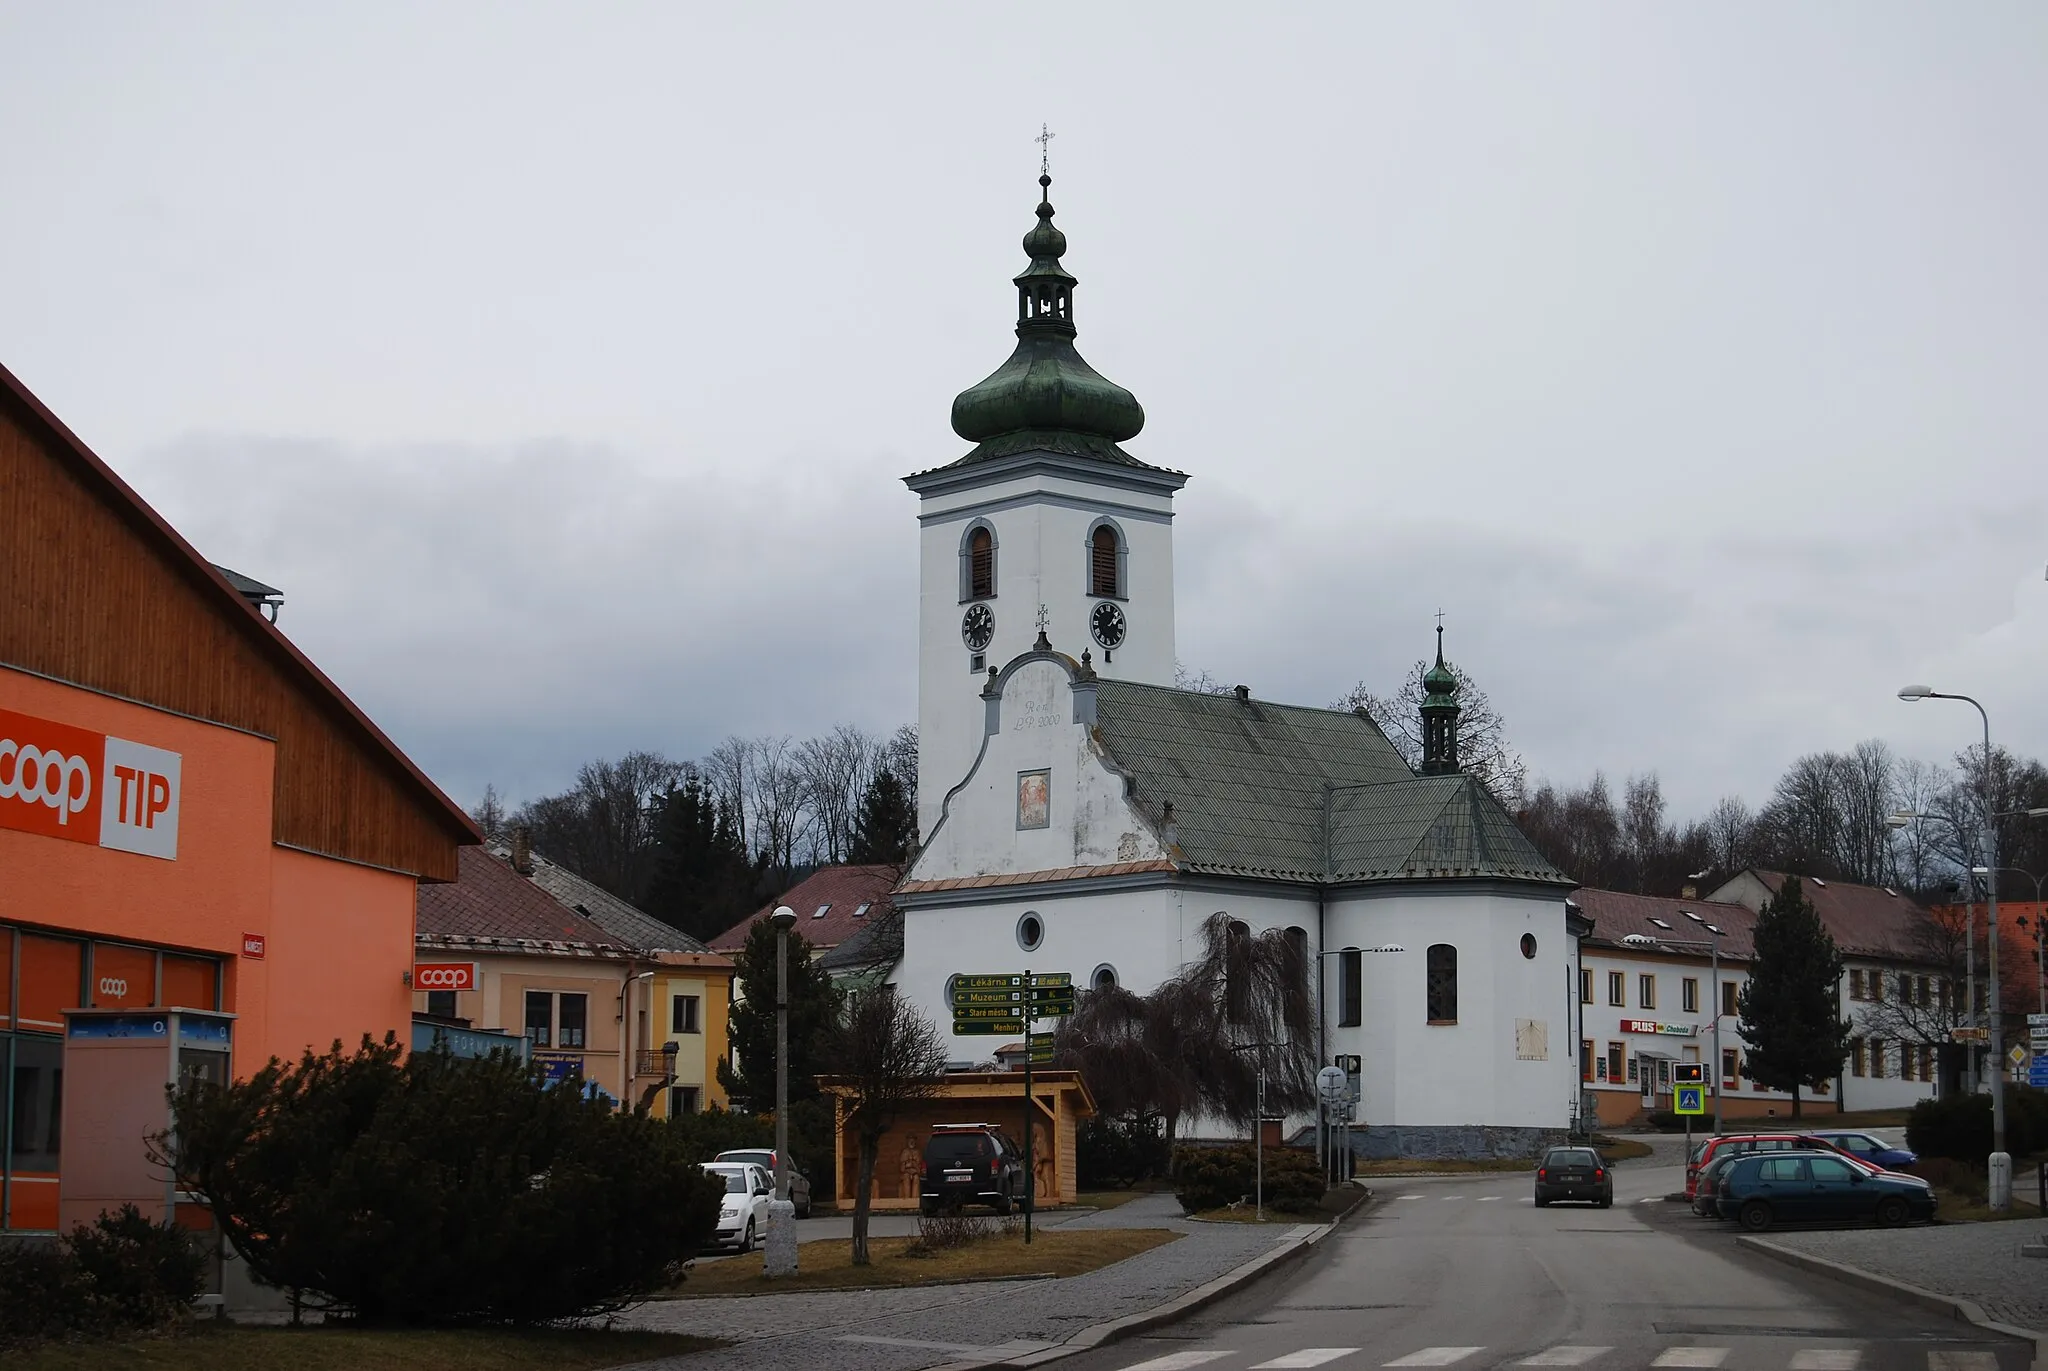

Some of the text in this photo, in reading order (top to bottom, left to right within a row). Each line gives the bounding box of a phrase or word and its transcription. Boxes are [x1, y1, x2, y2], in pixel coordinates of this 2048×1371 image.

[0, 738, 91, 825] coop
[114, 764, 170, 829] TIP
[420, 969, 468, 988] coop
[970, 977, 1007, 987] Lékárna
[100, 977, 127, 999] coop
[970, 993, 1007, 1002] Muzeum
[969, 1008, 1008, 1016] Staré město
[993, 1023, 1020, 1033] Menhiry
[1631, 1021, 1655, 1032] PLUS
